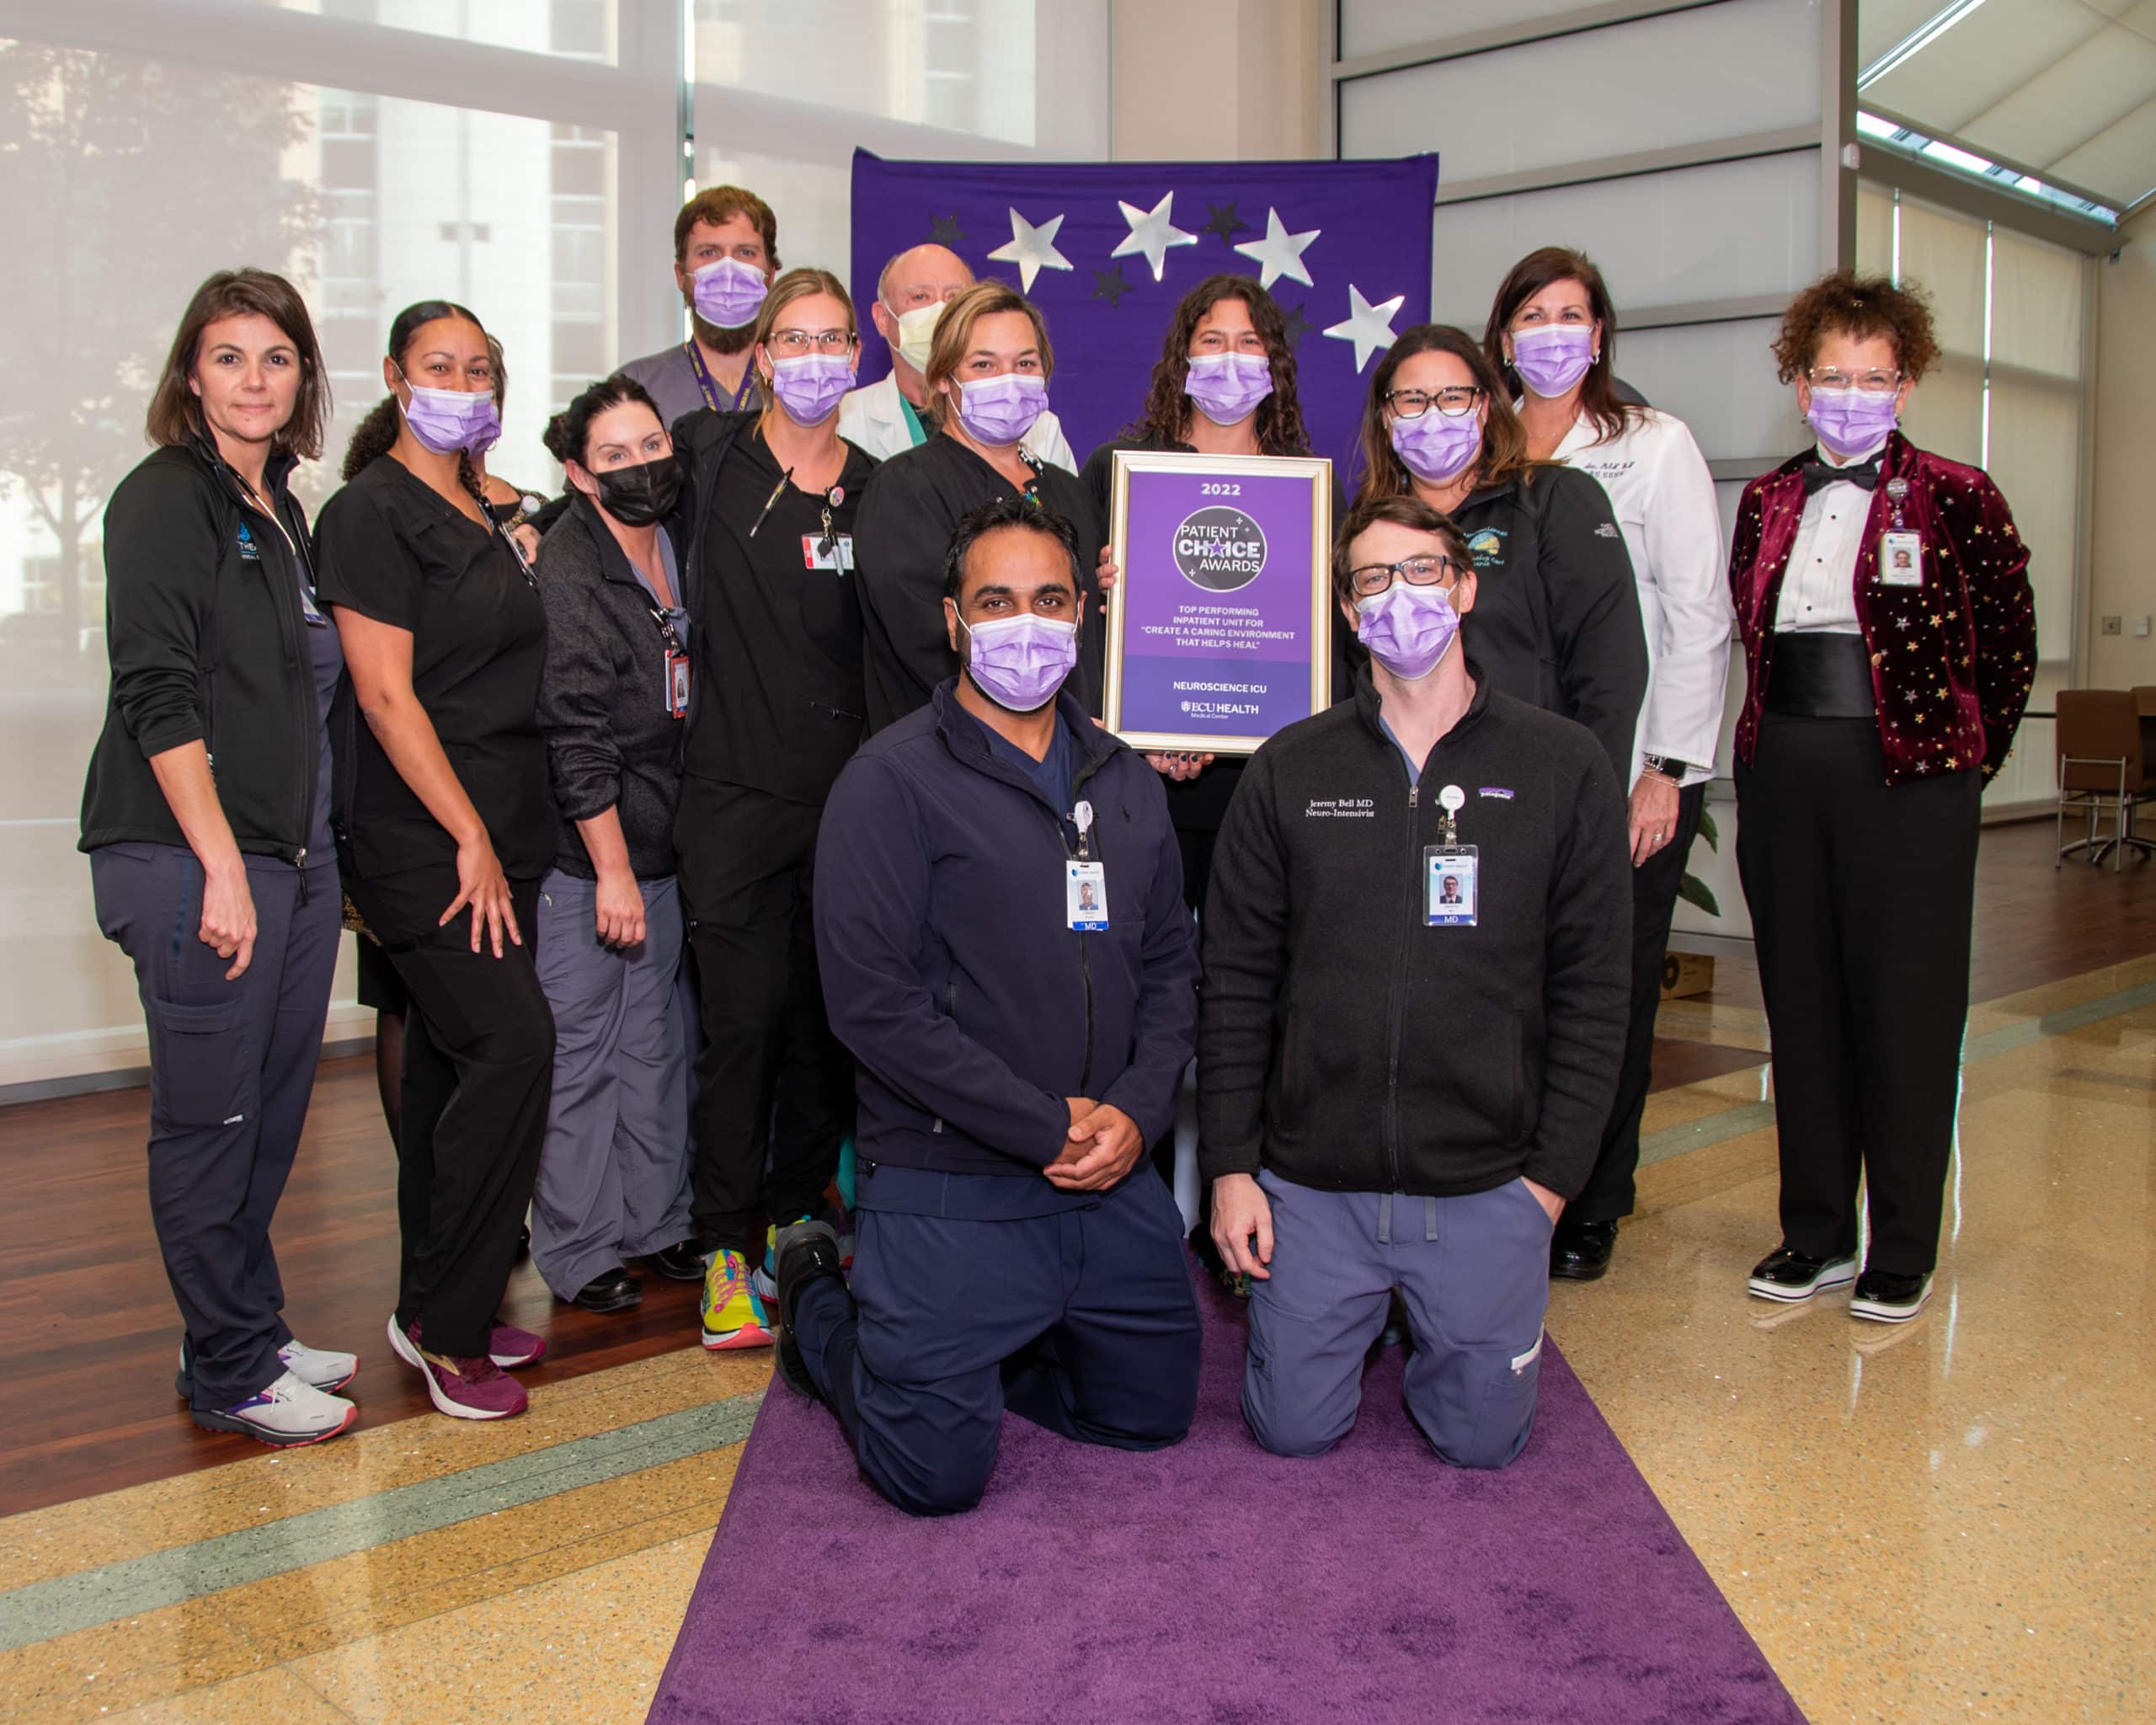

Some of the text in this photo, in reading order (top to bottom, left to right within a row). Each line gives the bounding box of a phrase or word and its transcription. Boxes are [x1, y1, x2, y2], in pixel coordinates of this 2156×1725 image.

[1201, 483, 1241, 496] 2022
[1181, 525, 1239, 538] PATIENT
[1199, 558, 1260, 573] AWARDS
[1179, 606, 1259, 617] TOP PERFORMING
[1173, 617, 1264, 628] INPATIENT UNIT FOR
[1191, 628, 1226, 637] CARING
[1227, 629, 1294, 640] ENVIRONMENT
[1176, 638, 1199, 647] THAT
[1201, 639, 1231, 649] HELPS
[1173, 681, 1267, 694] NEUROSCIENCE ICU
[1192, 702, 1259, 714] ECU HEALTH
[1309, 798, 1374, 809] Jeremy Bell MD
[1444, 916, 1459, 924] MD
[1084, 922, 1097, 931] MD
